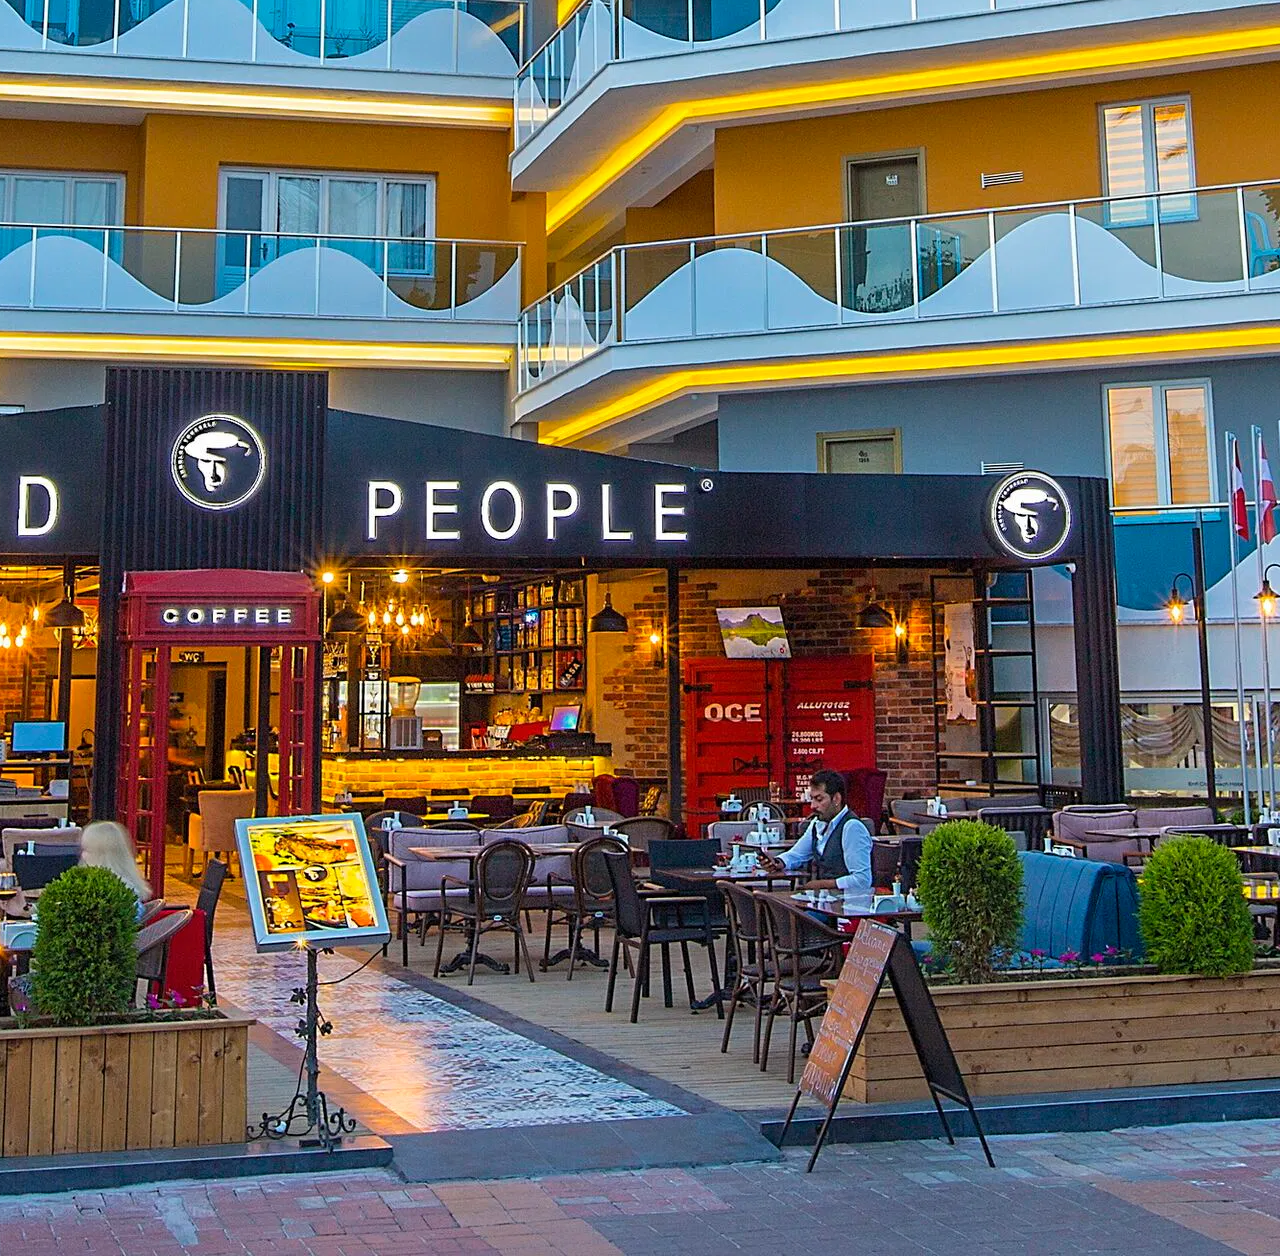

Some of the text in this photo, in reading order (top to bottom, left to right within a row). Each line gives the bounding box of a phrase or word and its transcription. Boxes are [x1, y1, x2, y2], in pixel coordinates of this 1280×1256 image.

[367, 480, 689, 541] PEOPLE
[162, 607, 293, 625] COFFEE
[184, 652, 201, 662] WC
[704, 702, 763, 722] OCE
